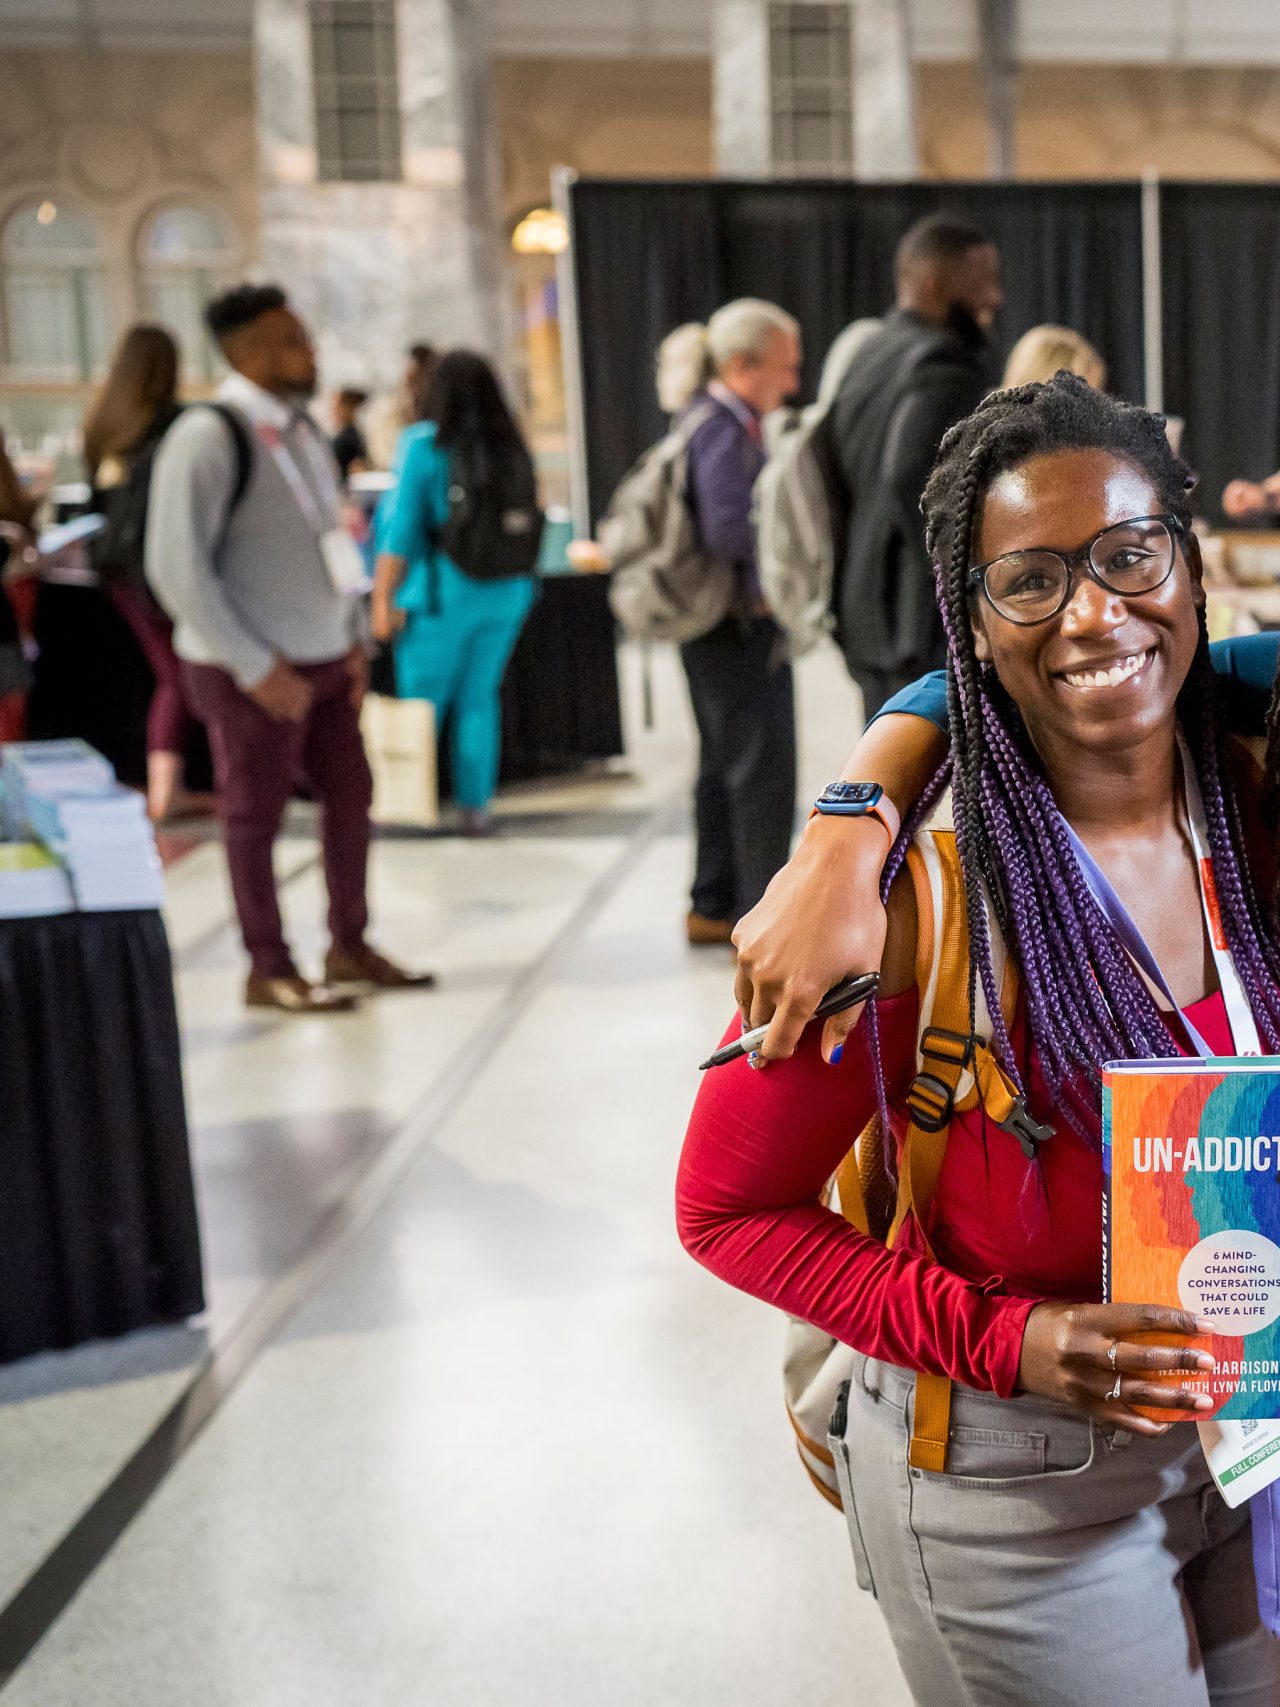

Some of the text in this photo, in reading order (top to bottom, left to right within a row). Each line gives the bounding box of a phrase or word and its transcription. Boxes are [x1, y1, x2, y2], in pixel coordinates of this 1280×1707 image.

[1213, 1251, 1257, 1260] 6 MIND-
[1204, 1265, 1266, 1274] CHANGING
[1200, 1293, 1269, 1301] THAT COULD
[1203, 1307, 1266, 1315] SAVE A LIFE
[1181, 1381, 1210, 1393] WITH
[1213, 1380, 1248, 1393] LYNYA
[1230, 1461, 1250, 1477] FULL
